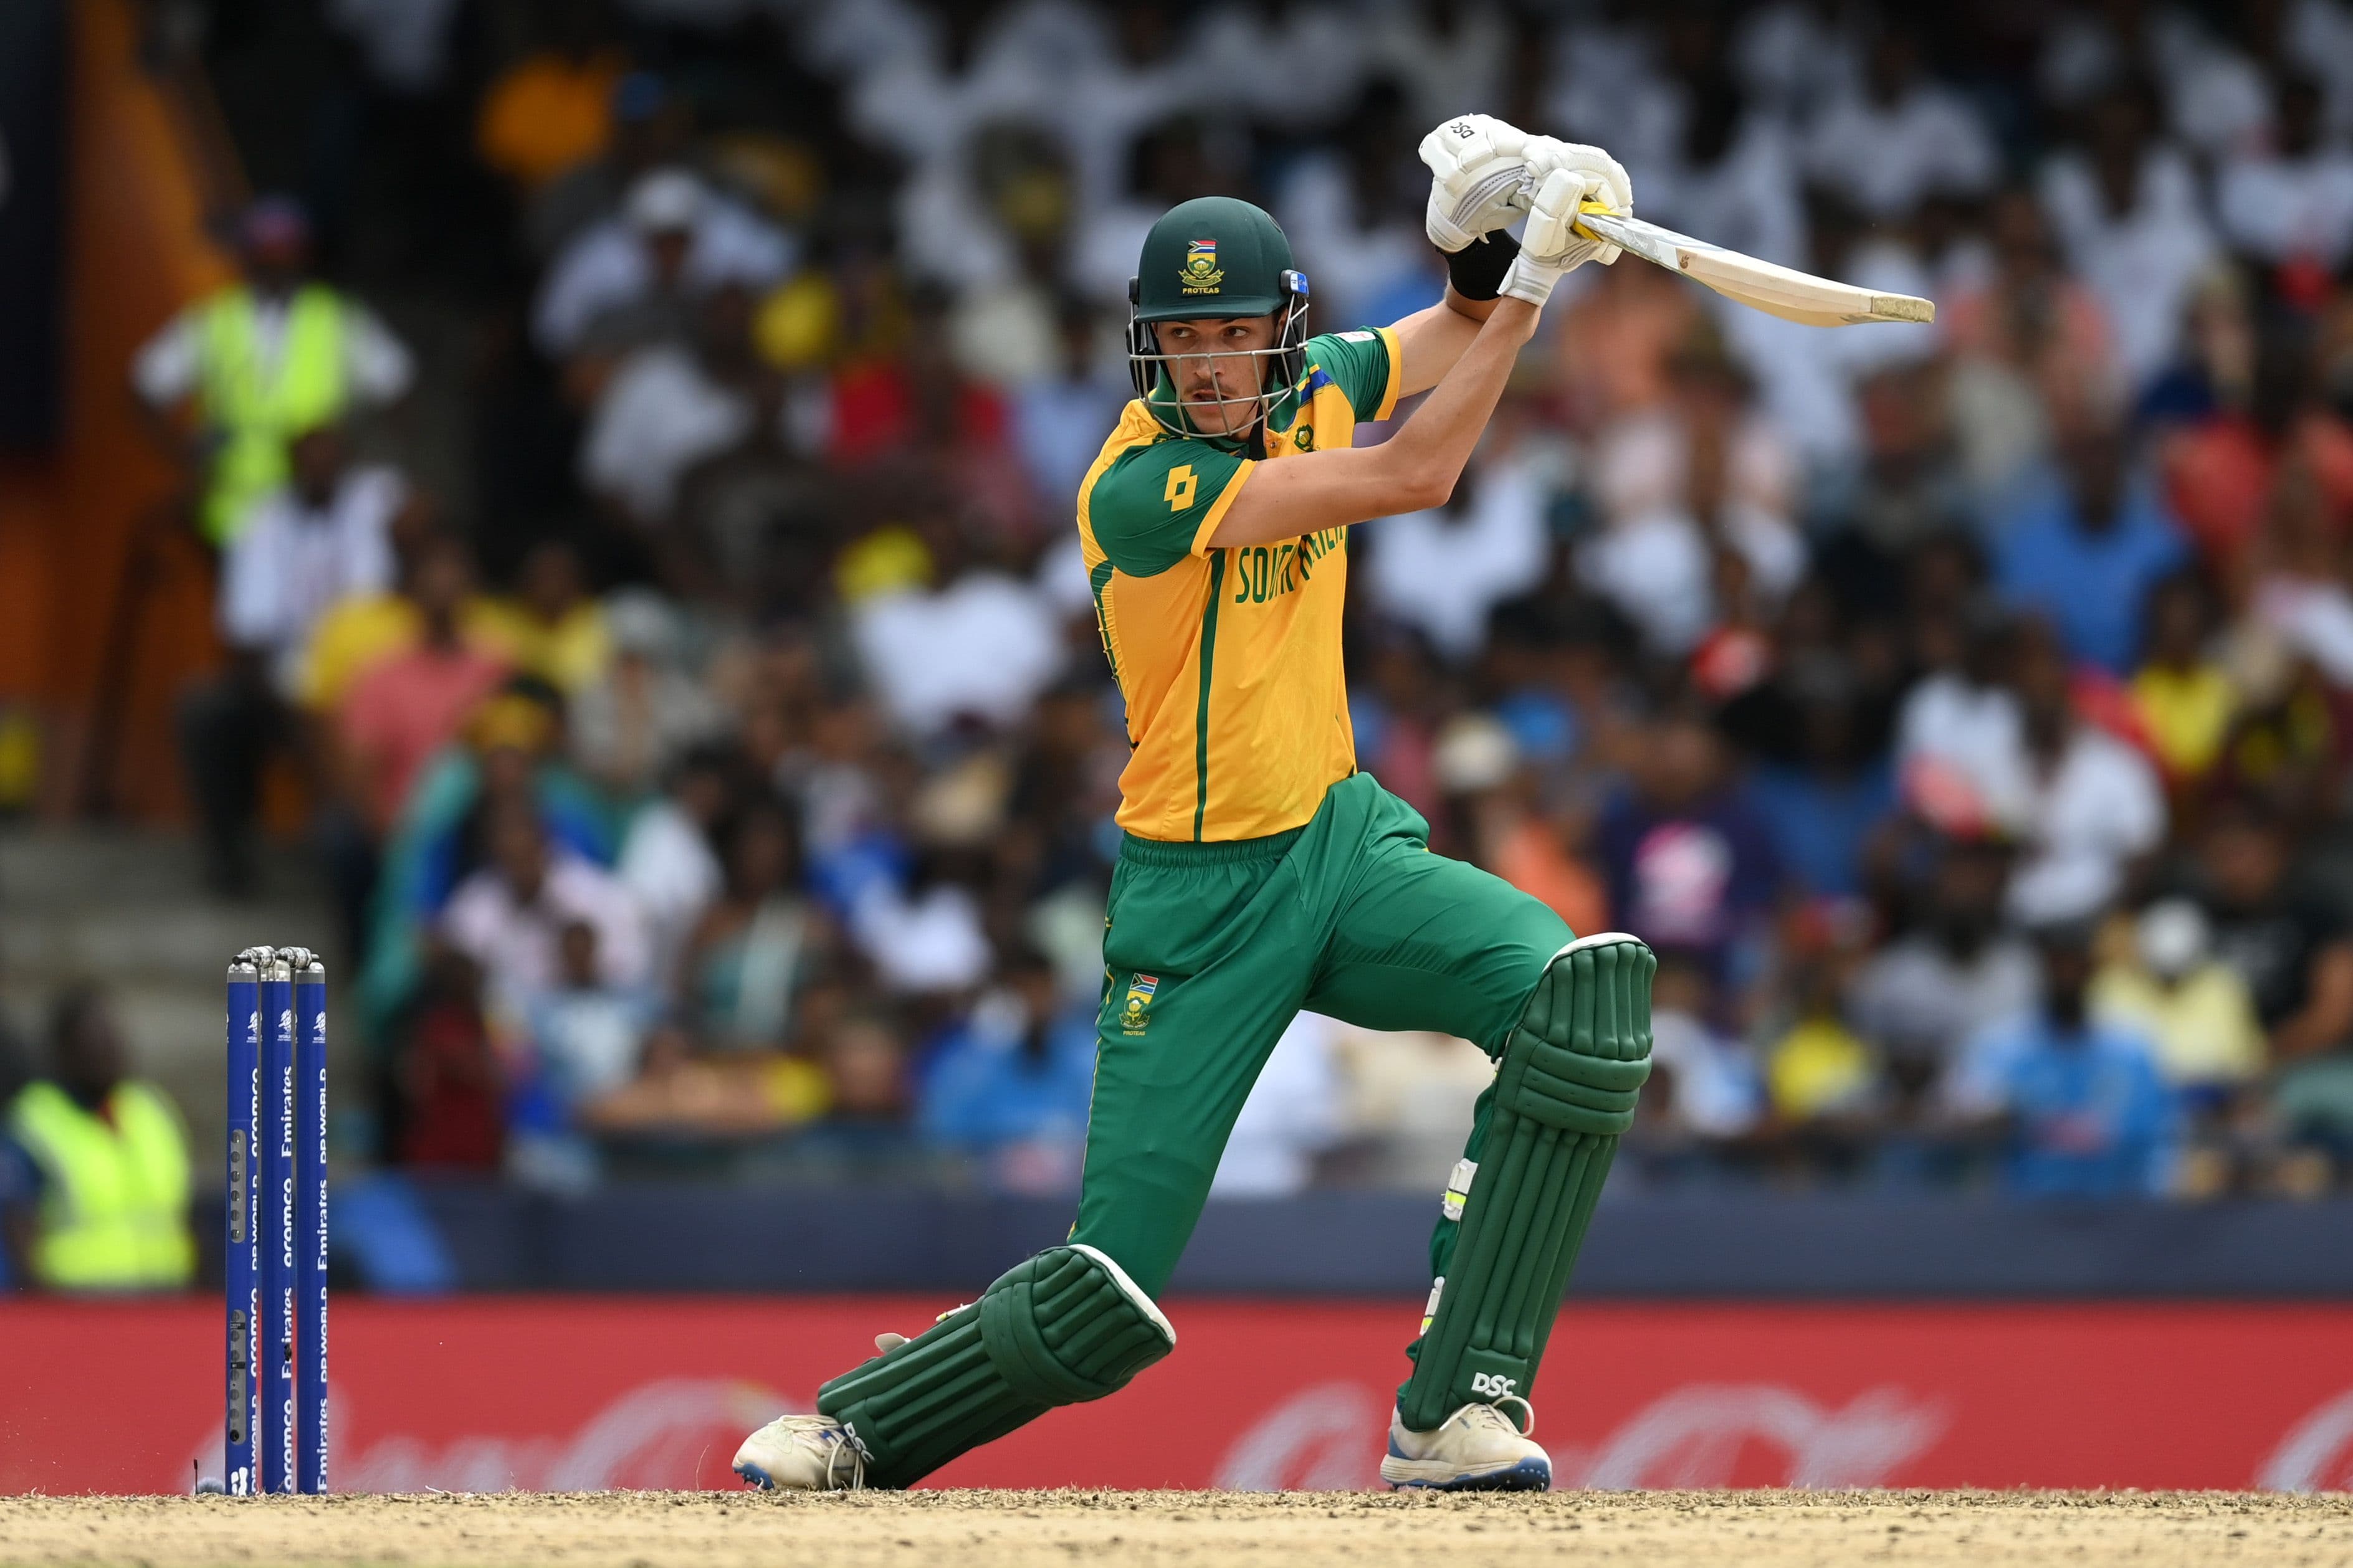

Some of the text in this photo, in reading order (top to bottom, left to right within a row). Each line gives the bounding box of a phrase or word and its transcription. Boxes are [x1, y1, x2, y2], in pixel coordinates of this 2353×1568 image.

[1450, 121, 1475, 139] DSC
[280, 1066, 292, 1157] Emirates
[284, 1177, 292, 1268] aramco
[317, 1179, 327, 1271] Emirates
[281, 1287, 292, 1379] Eirates
[1471, 1372, 1517, 1397] DSC
[284, 1399, 292, 1491] aramco
[317, 1397, 327, 1491] Emirates
[843, 1422, 875, 1463] DSC
